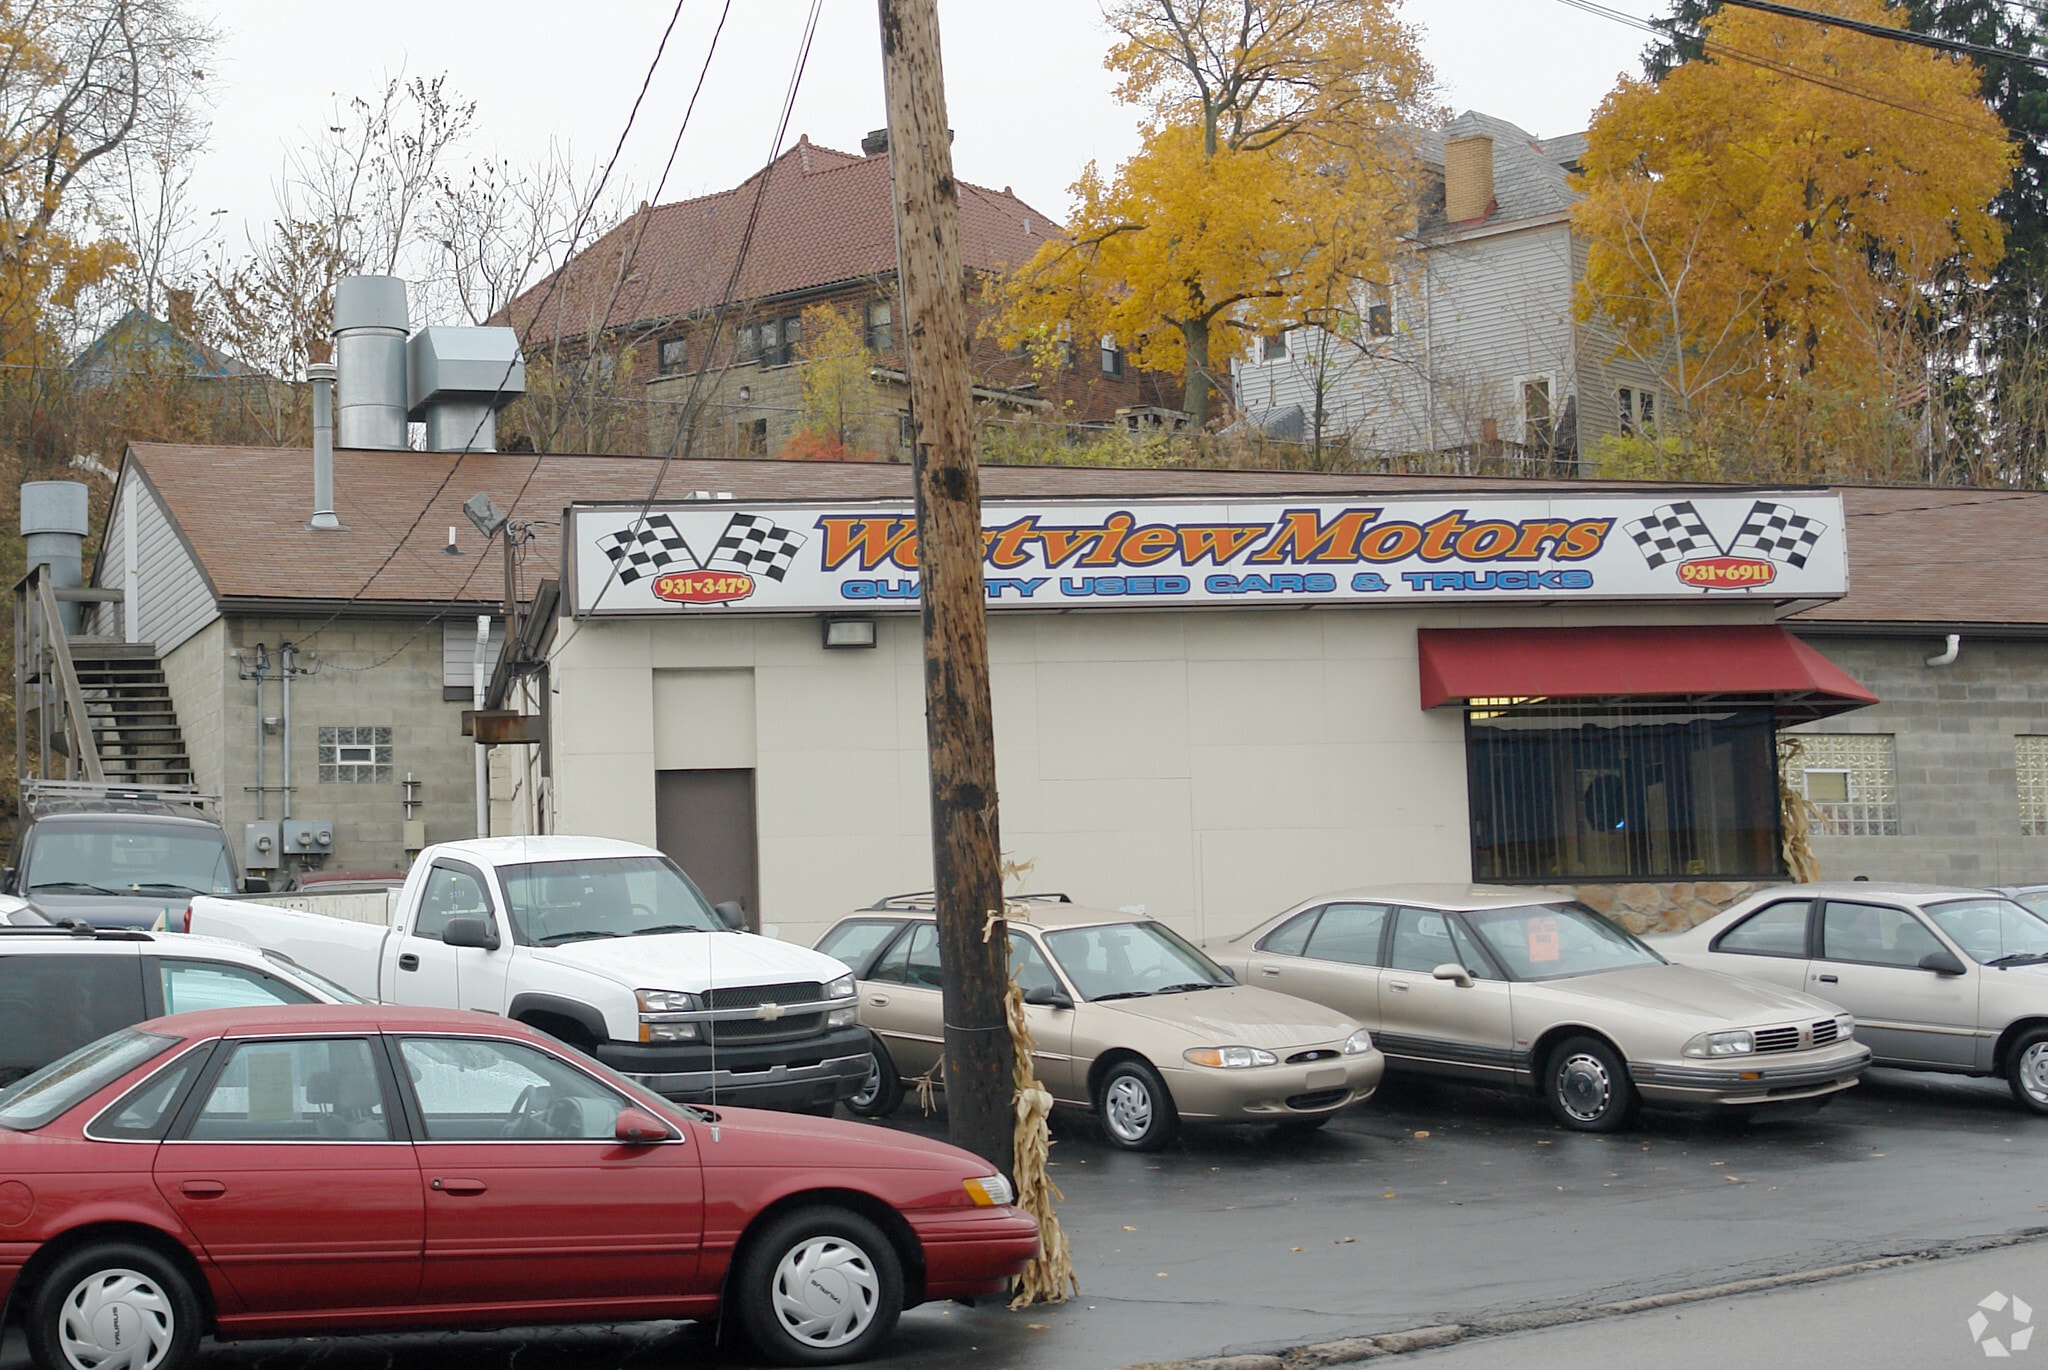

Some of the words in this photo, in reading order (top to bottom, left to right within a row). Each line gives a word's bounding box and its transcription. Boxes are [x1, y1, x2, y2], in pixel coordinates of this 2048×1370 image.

[1243, 507, 1618, 566] Motors
[841, 576, 1052, 600] QUTY
[1060, 575, 1190, 596] USED
[1204, 572, 1336, 594] CARS
[1350, 571, 1392, 592] &
[1401, 569, 1594, 591] TRUCKS
[810, 1279, 841, 1305] TAURUS
[112, 1306, 121, 1347] TAURUS
